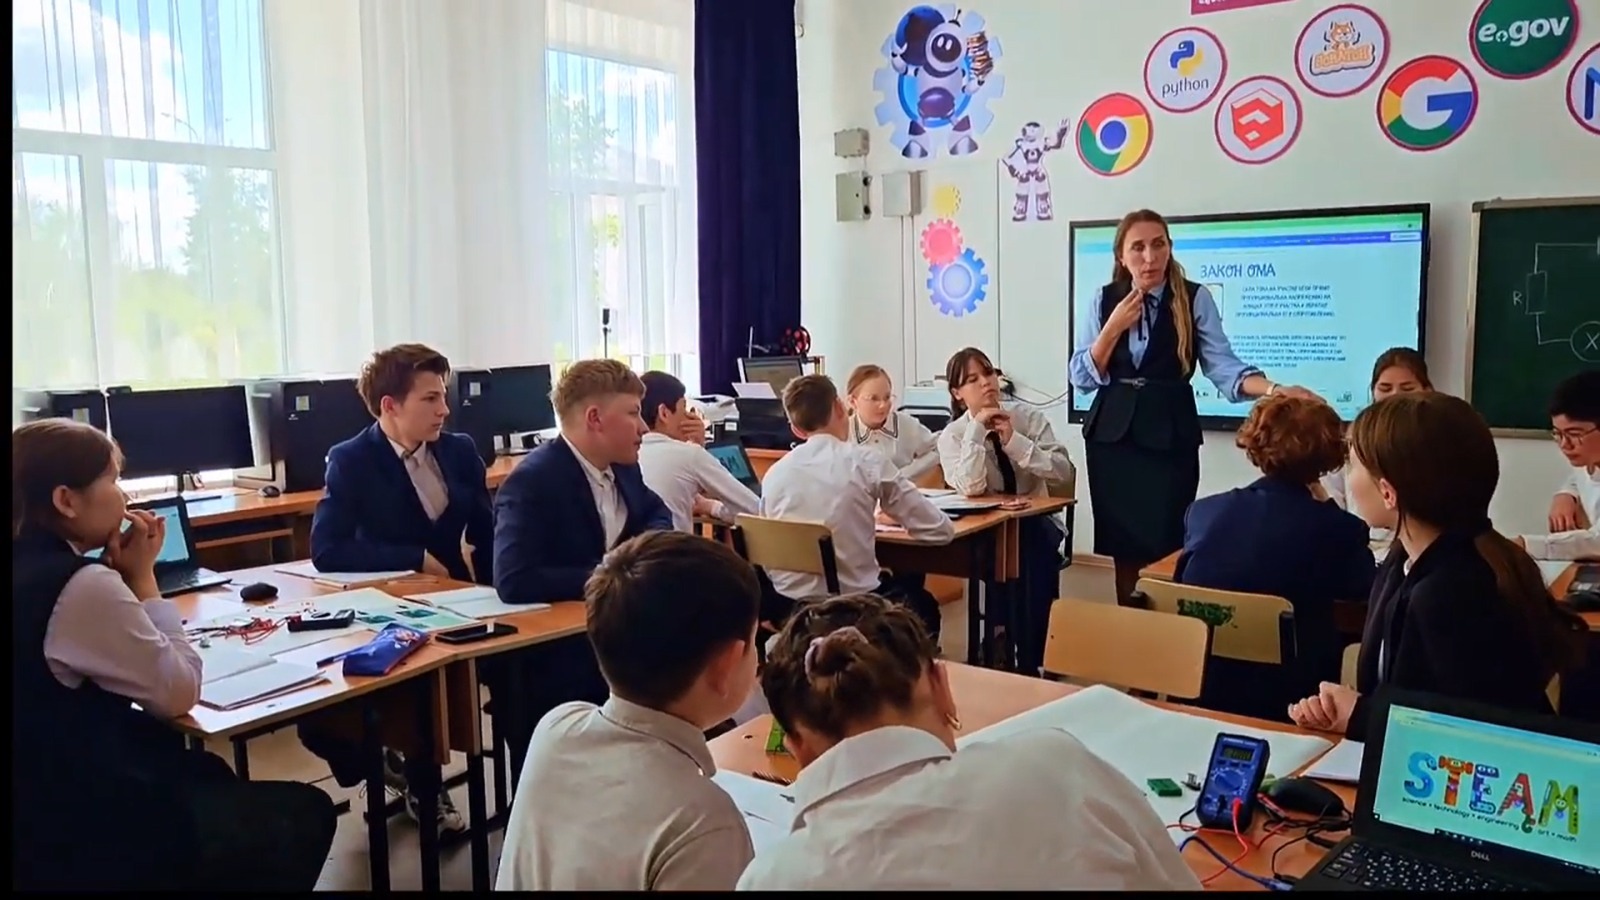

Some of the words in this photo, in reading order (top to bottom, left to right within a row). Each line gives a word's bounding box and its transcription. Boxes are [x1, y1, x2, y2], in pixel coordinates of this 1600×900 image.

[1162, 77, 1209, 98] python
[1200, 264, 1242, 279] ЗАКОН
[1247, 263, 1276, 278] ОМА
[1513, 291, 1522, 306] R
[1404, 751, 1579, 835] STEAM
[1434, 802, 1470, 819] technology
[1477, 814, 1519, 831] engineering
[1471, 850, 1490, 862] DELL
